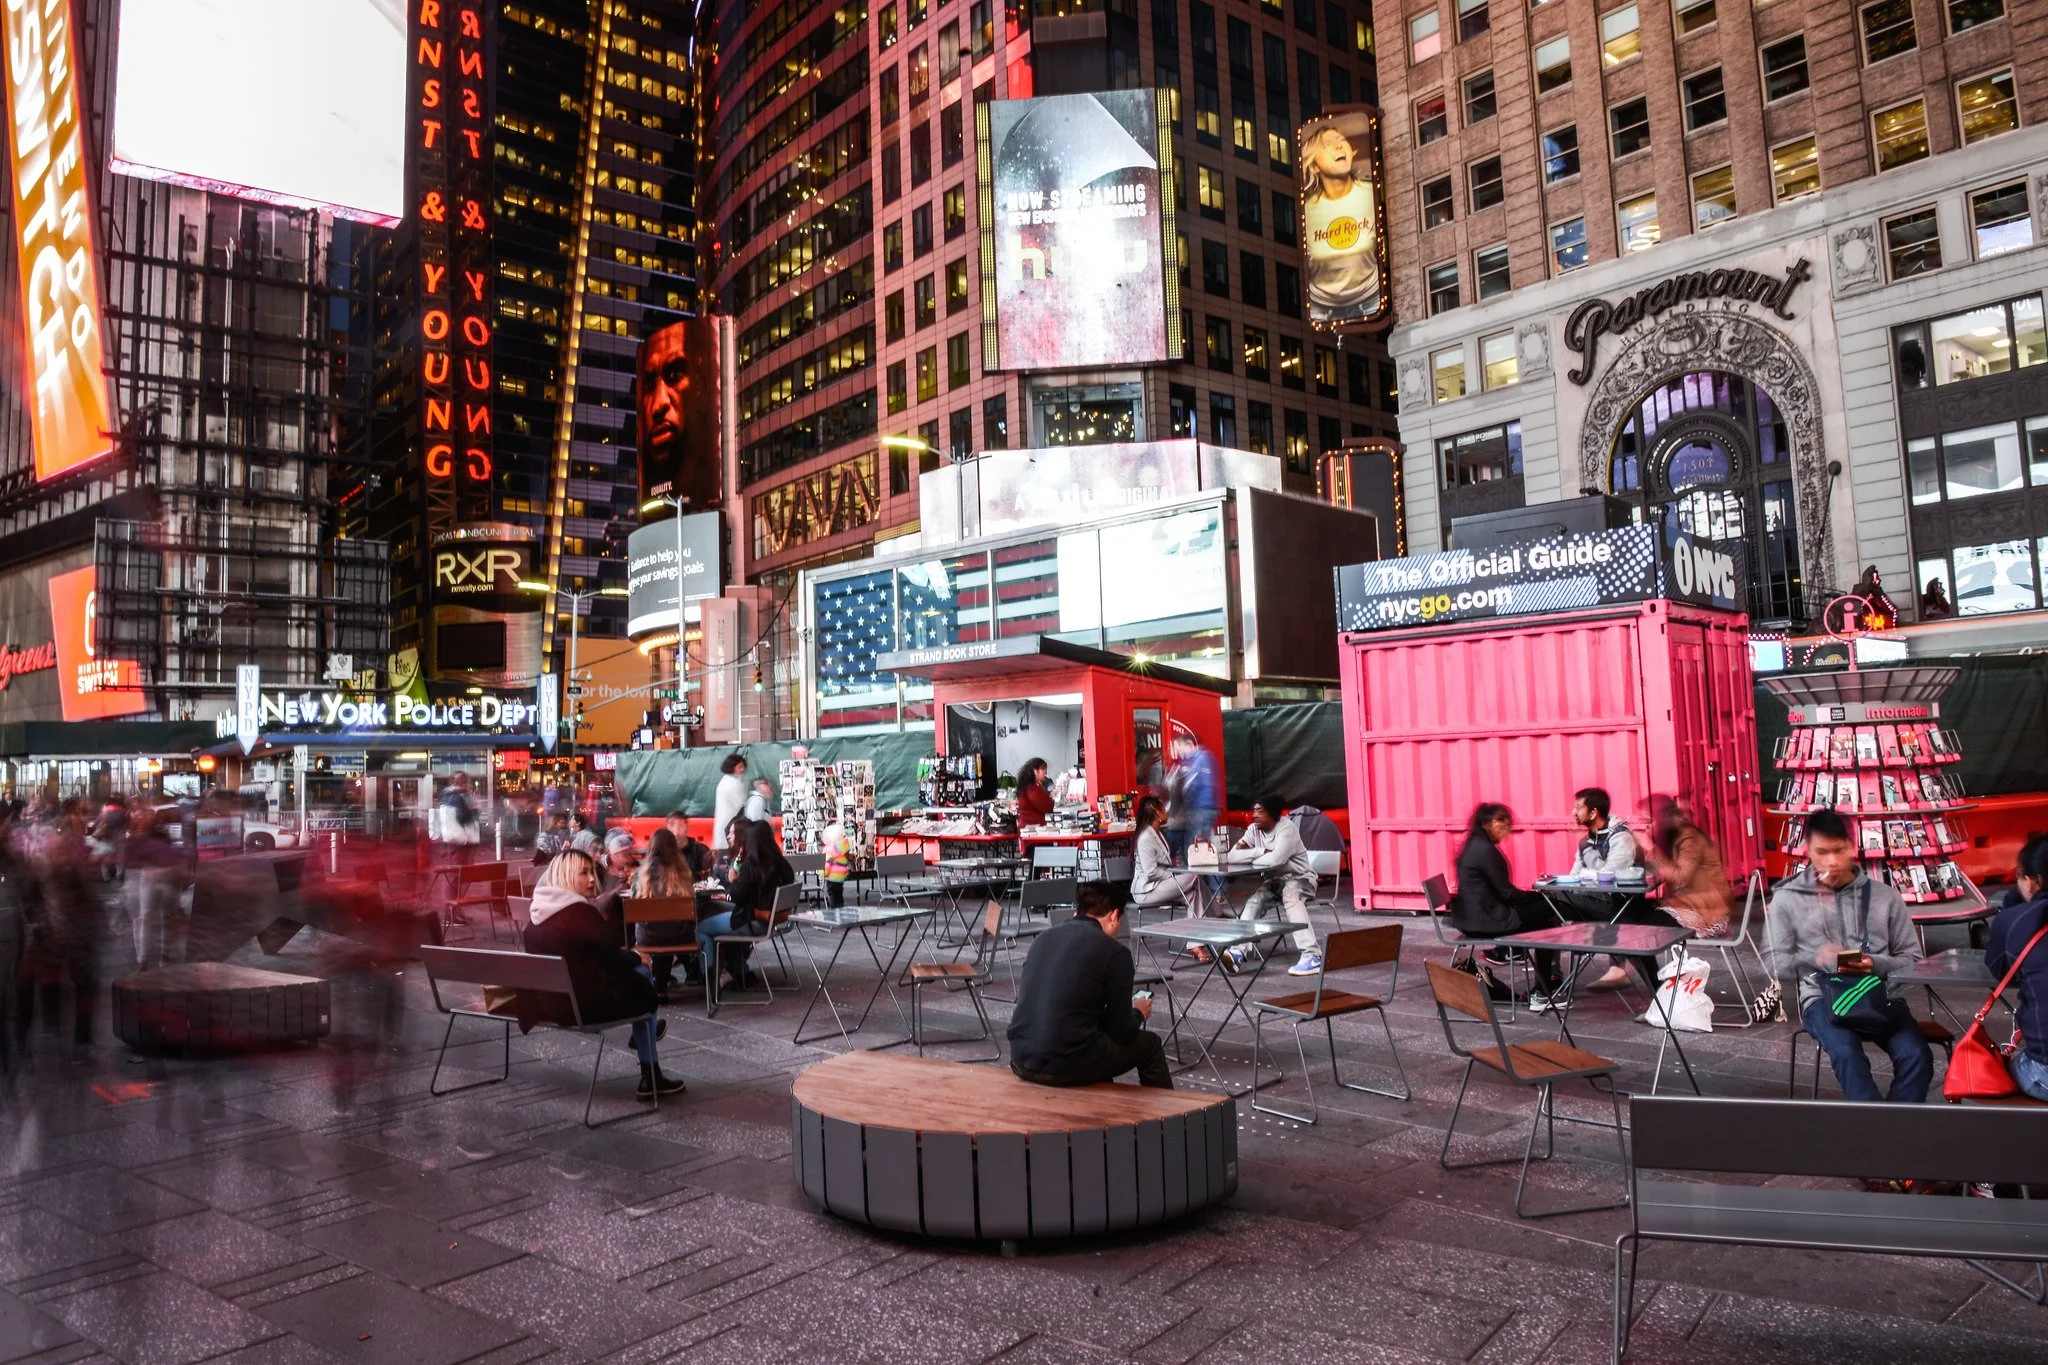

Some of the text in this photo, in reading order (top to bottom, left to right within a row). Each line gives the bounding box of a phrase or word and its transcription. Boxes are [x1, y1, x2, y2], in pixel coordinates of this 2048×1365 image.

[45, 0, 92, 349] INTENDO
[11, 11, 68, 397] SWITCH
[421, 191, 446, 222] &
[1007, 190, 1043, 211] NOW
[1314, 216, 1369, 242] Hard Rock
[1008, 233, 1148, 281] huu
[1564, 256, 1812, 386] Paramount
[1620, 301, 1750, 347] BUILDING
[423, 263, 452, 477] YOUNG
[436, 549, 522, 588] RXR
[650, 554, 657, 565] to
[657, 548, 674, 564] help
[674, 547, 692, 563] yu
[652, 566, 680, 581] savings
[1377, 538, 1612, 590] The Official Guide
[1694, 545, 1736, 600] NYC
[1379, 585, 1514, 622] nycgo.com
[909, 643, 997, 665] STRAND BOOK STORE
[77, 670, 119, 694] SWITCH
[244, 668, 254, 734] NYPD
[602, 684, 622, 698] the
[260, 691, 320, 725] NEW
[322, 692, 388, 726] YORK
[395, 694, 474, 726] POLICE
[481, 696, 539, 726] DEPT
[545, 677, 554, 733] NYPD
[1865, 704, 1929, 720] Information
